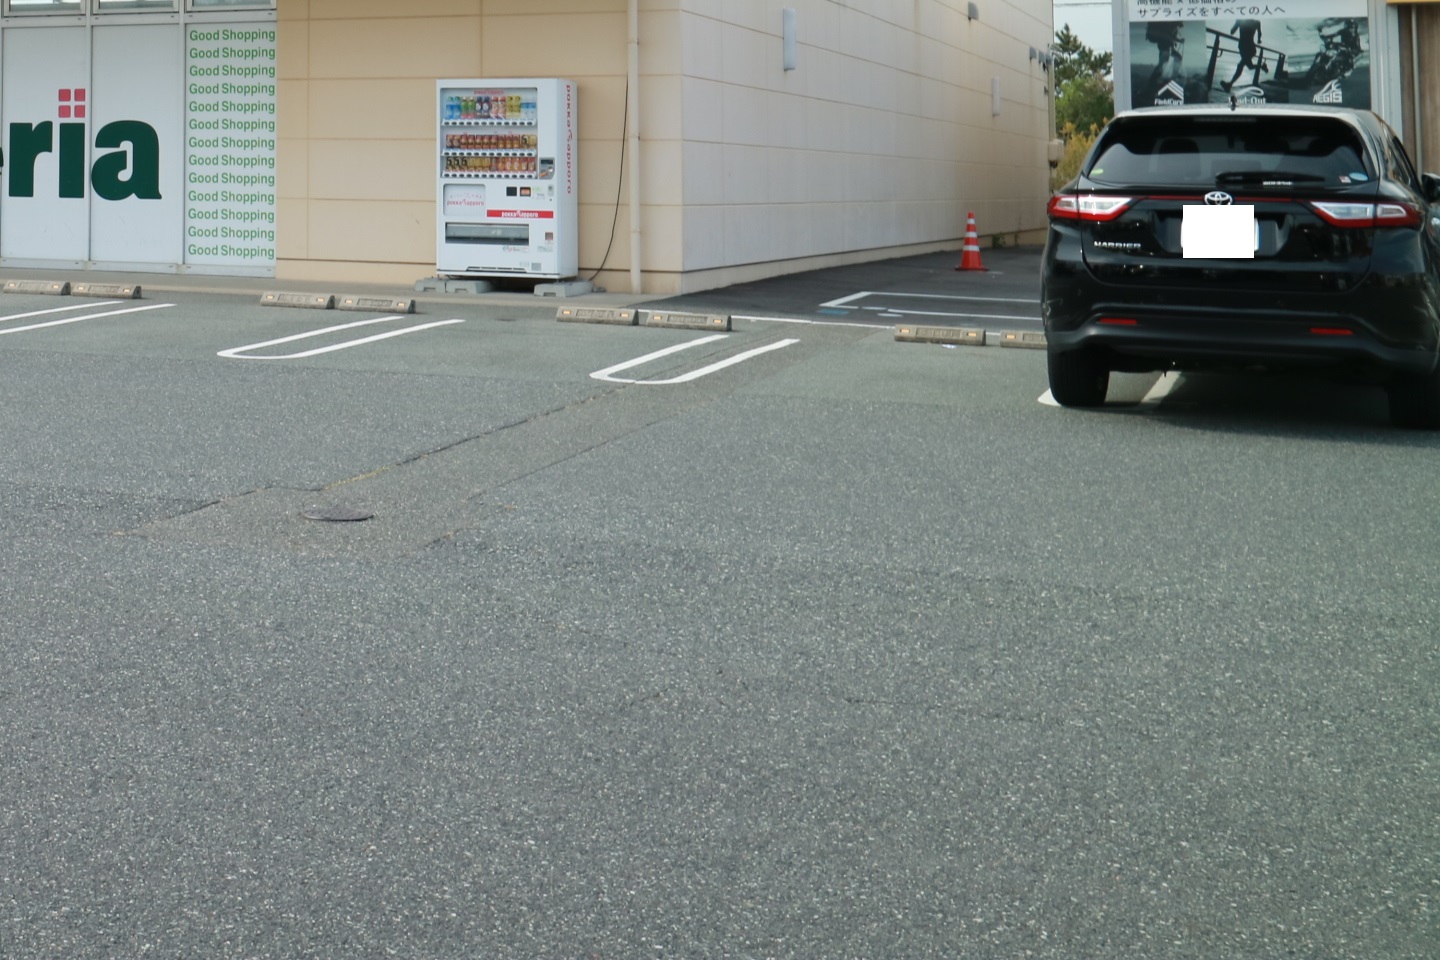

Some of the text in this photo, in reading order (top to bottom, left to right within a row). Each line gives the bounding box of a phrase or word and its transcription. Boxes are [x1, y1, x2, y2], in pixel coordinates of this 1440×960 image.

[190, 29, 276, 42] Good Shopping
[189, 46, 275, 59] Good Shopping
[189, 64, 275, 77] Good Shopping
[189, 82, 275, 96] Good Shopping
[189, 100, 275, 114] Good Shopping
[189, 118, 275, 132] Good Shopping
[189, 136, 275, 150] Good Shopping
[189, 154, 275, 168] Good Shopping
[188, 172, 274, 186] Good Shopping
[188, 190, 274, 204] Good Shopping
[188, 208, 274, 222] Good Shopping
[188, 226, 274, 240] Good Shopping
[188, 244, 274, 258] Good Shopping
